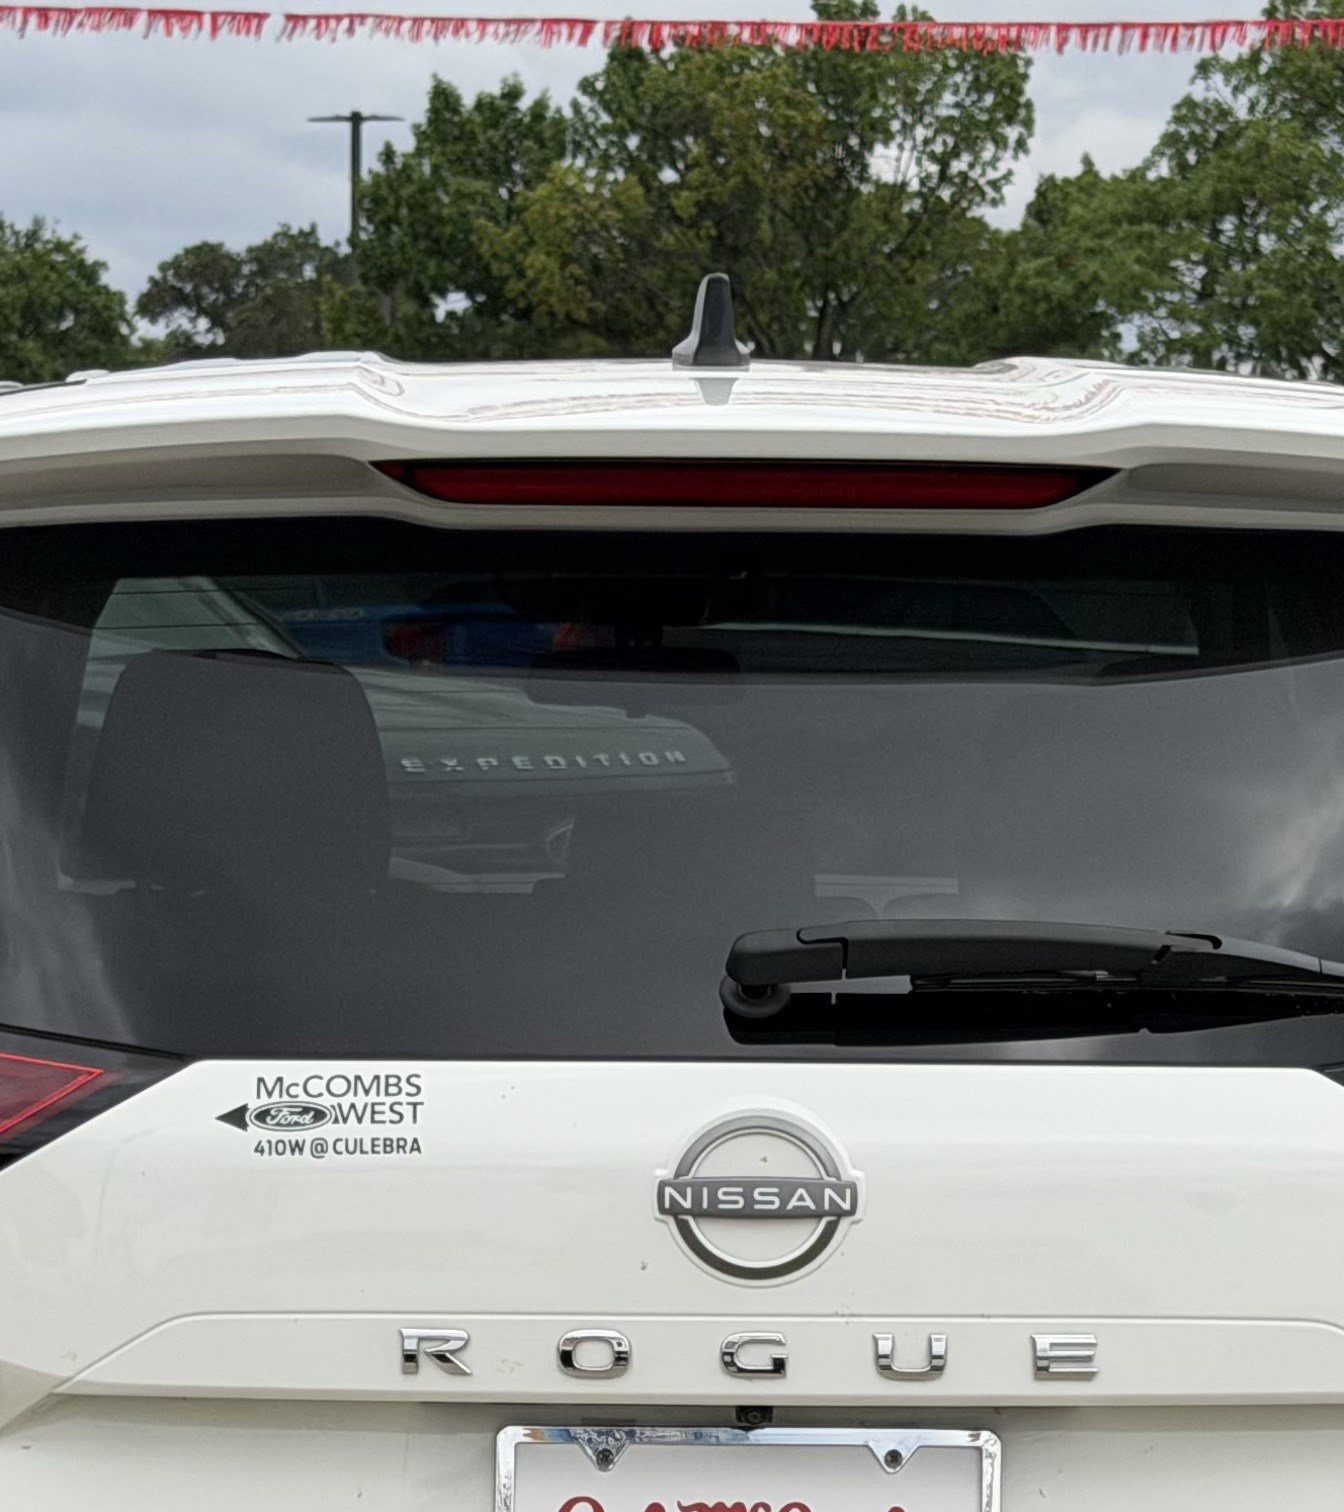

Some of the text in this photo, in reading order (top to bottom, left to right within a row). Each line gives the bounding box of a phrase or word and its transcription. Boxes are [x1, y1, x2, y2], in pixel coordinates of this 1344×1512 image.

[399, 750, 687, 773] EXPEDITION
[255, 1073, 423, 1100] McCOMBS
[337, 1101, 425, 1125] WEST
[332, 1137, 423, 1156] CULEBRA
[664, 1186, 851, 1211] NISSAN
[398, 1327, 1100, 1380] ROGUE
